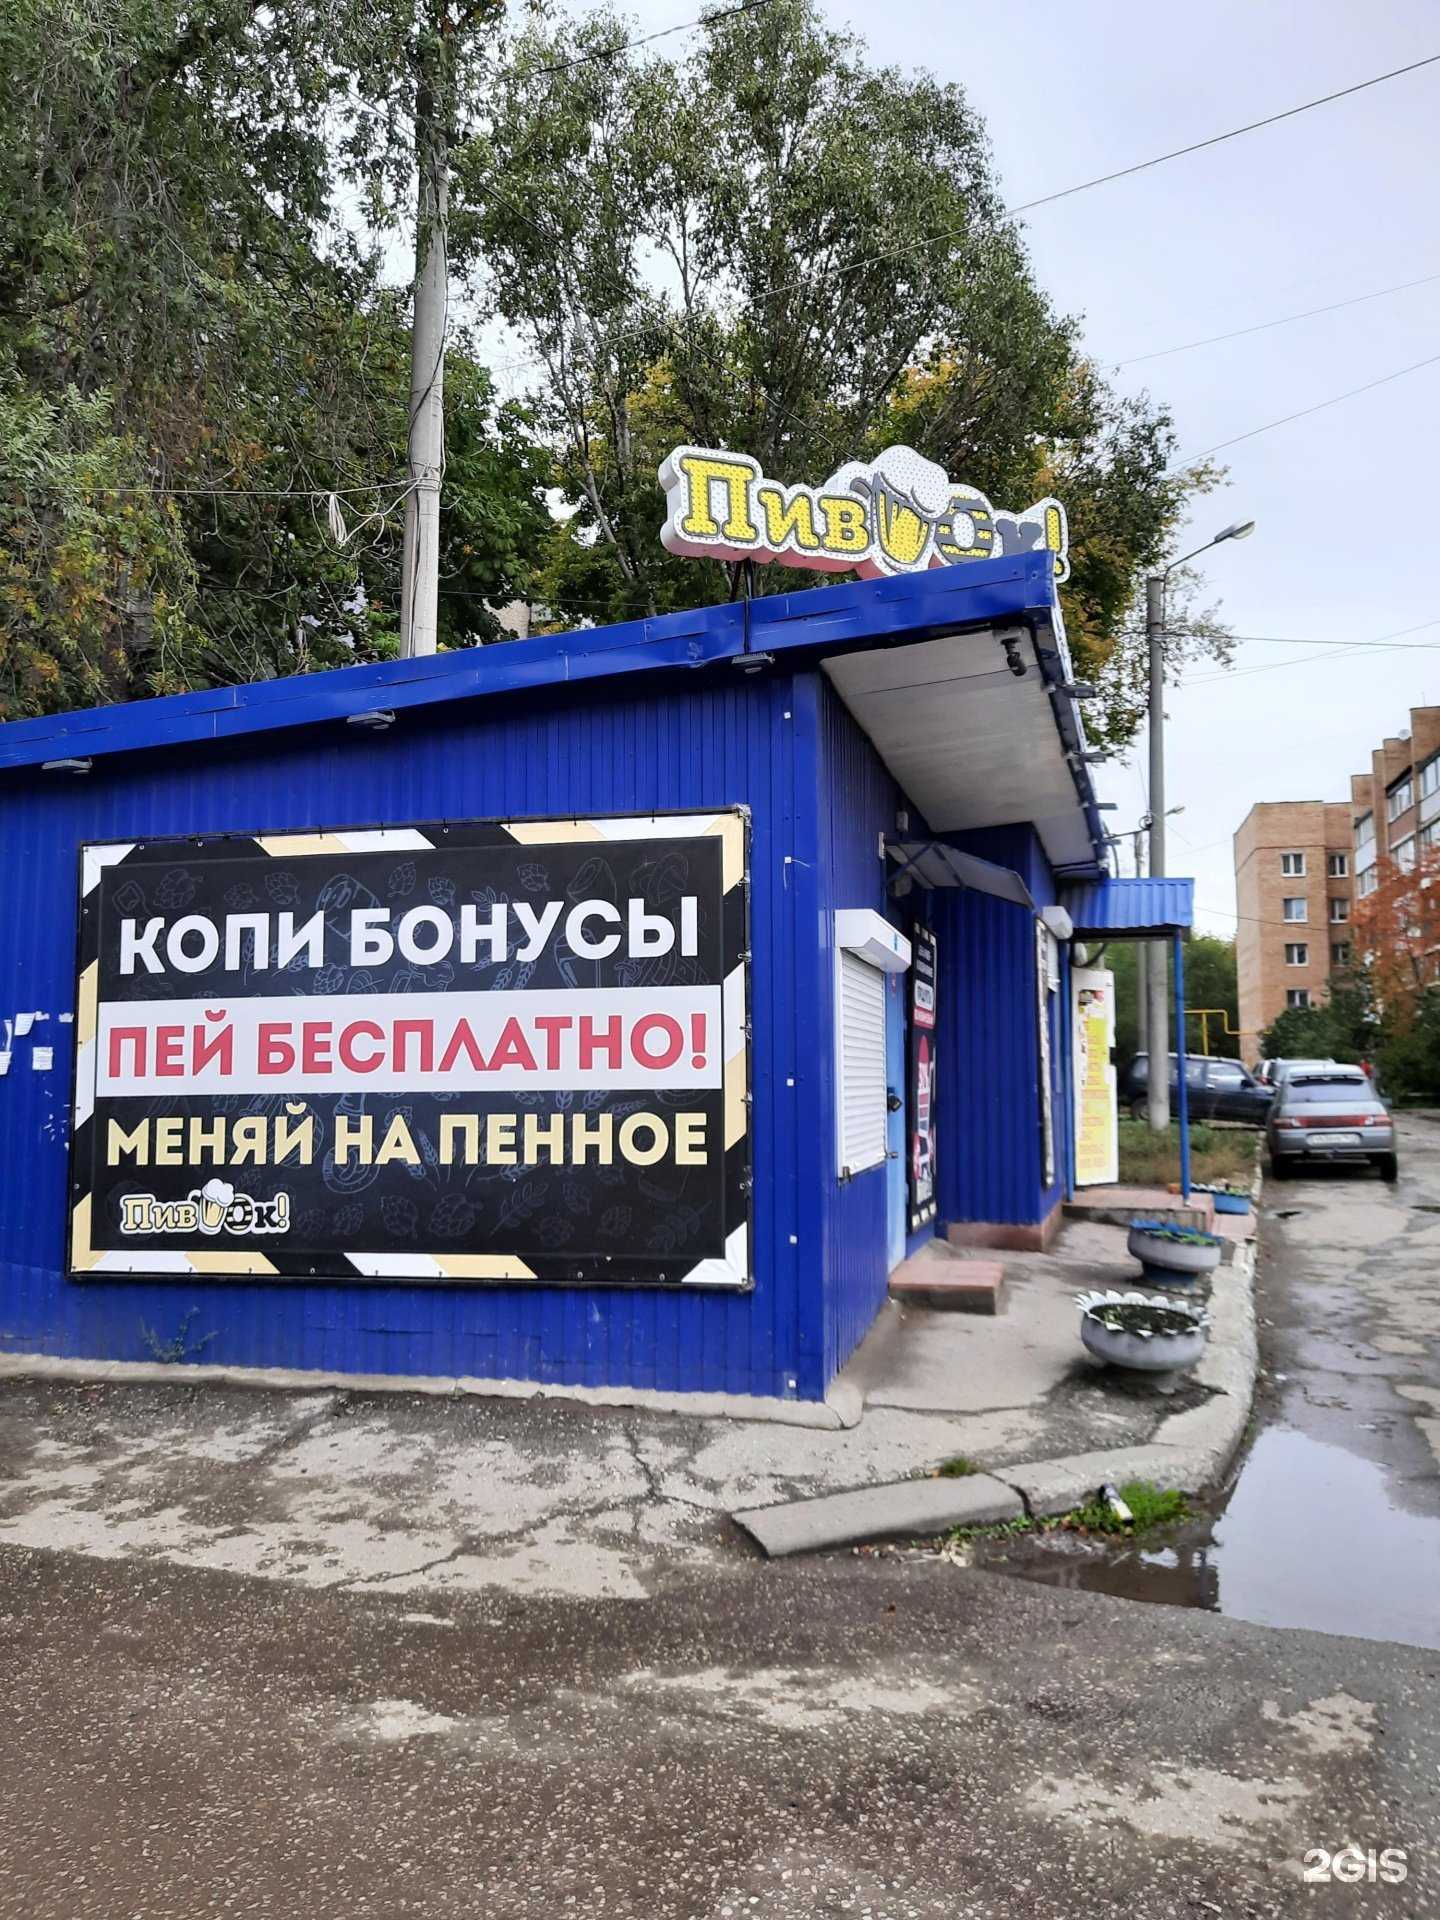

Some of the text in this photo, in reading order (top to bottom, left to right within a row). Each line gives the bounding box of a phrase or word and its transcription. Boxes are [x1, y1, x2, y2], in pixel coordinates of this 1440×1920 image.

[119, 896, 699, 976] КОПИ БОНУСЫ
[108, 1009, 708, 1079] ПЕЙ БЕСПЛАТНО!
[107, 1102, 709, 1167] МЕНЯЙ НА ПЕННОЕ
